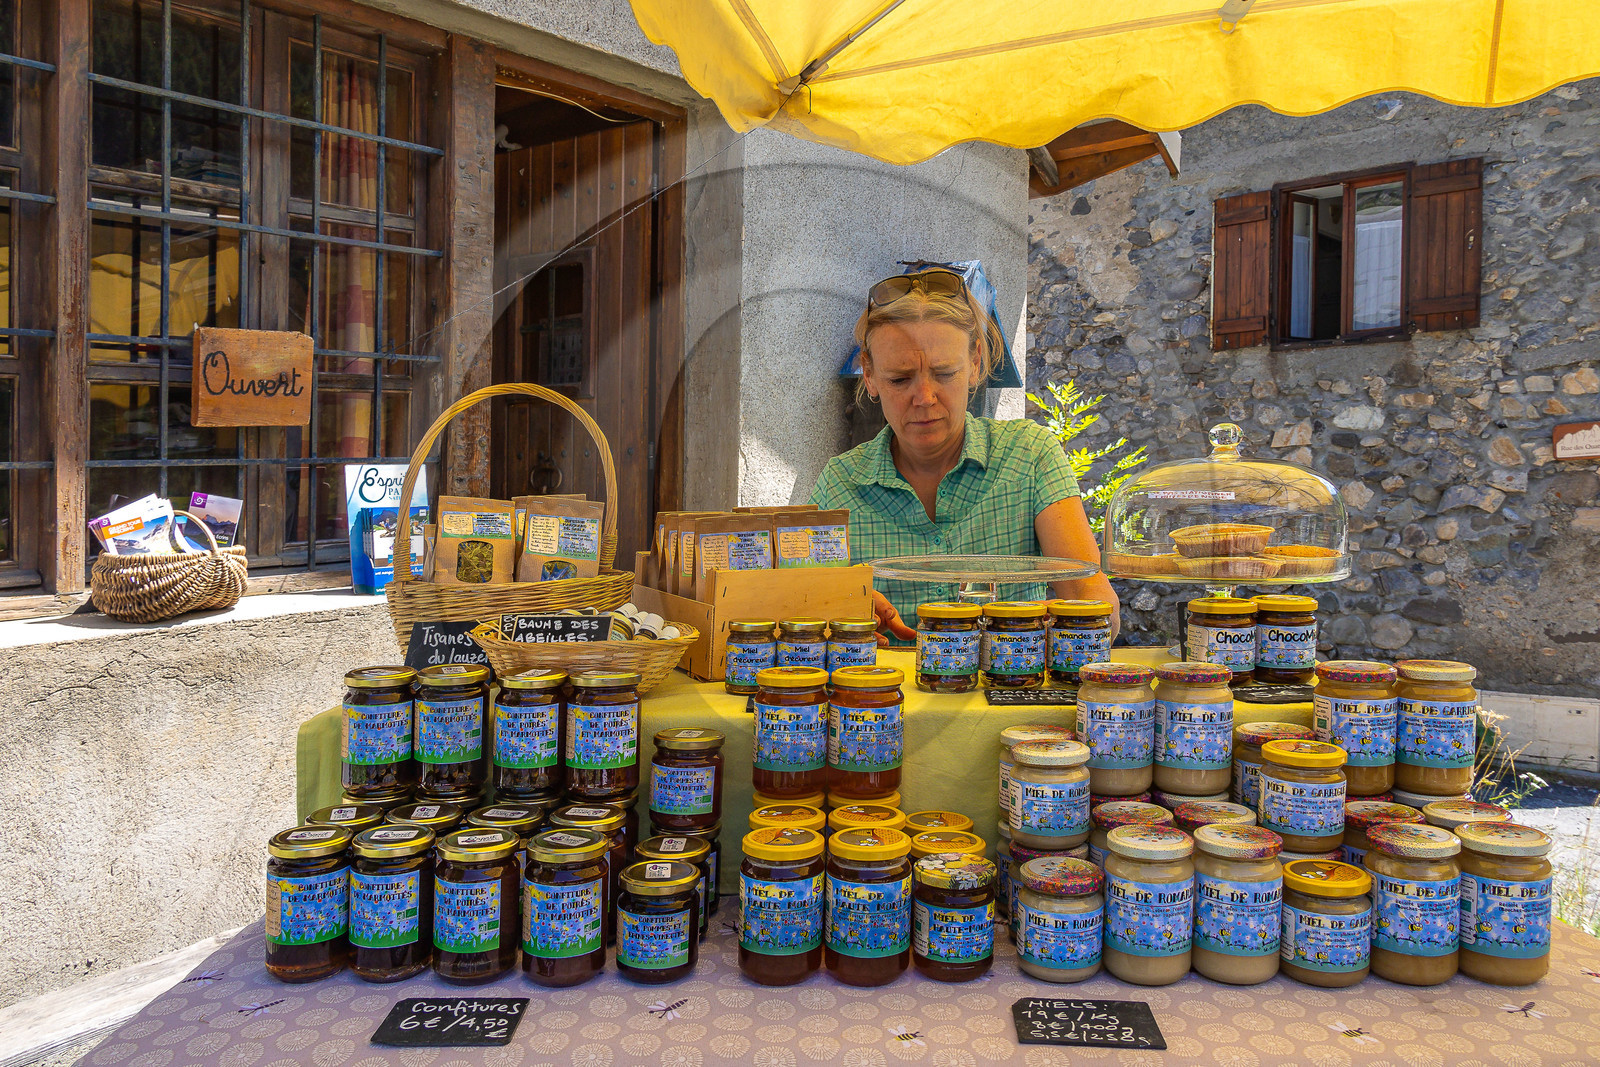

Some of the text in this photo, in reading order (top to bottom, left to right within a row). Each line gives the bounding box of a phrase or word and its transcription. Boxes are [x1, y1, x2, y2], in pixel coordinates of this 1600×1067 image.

[203, 351, 304, 397] Ouvert
[518, 619, 564, 630] BAUME
[571, 620, 600, 630] DES
[422, 625, 473, 648] Tisanes
[927, 635, 959, 643] Amandes
[997, 635, 1030, 643] Amandes
[1058, 631, 1091, 640] Amandes
[742, 647, 758, 655] Miel
[794, 646, 810, 654] Miel
[845, 646, 861, 654] Miel
[1088, 643, 1101, 651] miel
[428, 650, 446, 666] du
[429, 705, 470, 714] CONFITURE
[1334, 702, 1361, 714] MIEL
[1366, 704, 1381, 714] DE
[1421, 705, 1439, 715] DE
[361, 711, 403, 721] CONFITURE
[422, 715, 432, 723] DE
[507, 711, 547, 720] CONFITURE
[589, 710, 630, 719] CONFITURE
[760, 711, 803, 722] MIEL DE
[843, 713, 888, 723] MIEL DE
[1090, 709, 1115, 721] MIEL
[1121, 710, 1135, 721] DE
[1170, 709, 1197, 723] MIEL
[1202, 711, 1216, 723] DE
[353, 722, 362, 730] DE
[507, 721, 517, 729] DE
[589, 721, 598, 729] DE
[760, 721, 791, 732] HAUTE
[843, 722, 877, 732] HAUTE
[500, 728, 555, 739] ET MARMOTTES
[581, 728, 635, 739] ET MARMOTTES
[1245, 765, 1259, 776] MIE
[1025, 787, 1048, 799] MIEL
[1052, 789, 1065, 799] DE
[1267, 781, 1288, 793] MIEL
[1291, 786, 1307, 797] DE
[298, 878, 344, 892] CONFITURE
[359, 882, 403, 891] CONFITURE
[1380, 880, 1410, 896] MIEL
[1416, 887, 1435, 898] DE
[1481, 883, 1514, 898] MIEL
[1519, 887, 1537, 898] DE
[353, 890, 363, 899] DE
[443, 888, 487, 898] CONFITURE
[545, 888, 592, 899] CONFITURE
[747, 886, 796, 900] MIEL DE
[834, 887, 885, 902] MIEL DE
[1108, 882, 1129, 901] MIEL
[1136, 892, 1153, 904] DE
[1198, 883, 1224, 902] MIEL
[1230, 892, 1249, 904] DE
[288, 894, 299, 904] DE
[444, 897, 453, 906] DE
[747, 897, 782, 911] HAUTE
[545, 902, 558, 912] DE
[834, 898, 871, 912] HAUTE
[437, 905, 497, 918] ET MARMOTTES
[537, 907, 599, 922] ET MARMOTTES
[933, 912, 976, 924] MIEL DE
[1028, 912, 1050, 928] MIEL
[1055, 919, 1069, 931] DE
[1300, 915, 1325, 930] MIEL
[1330, 920, 1345, 931] DE
[412, 1000, 521, 1016] Confitures
